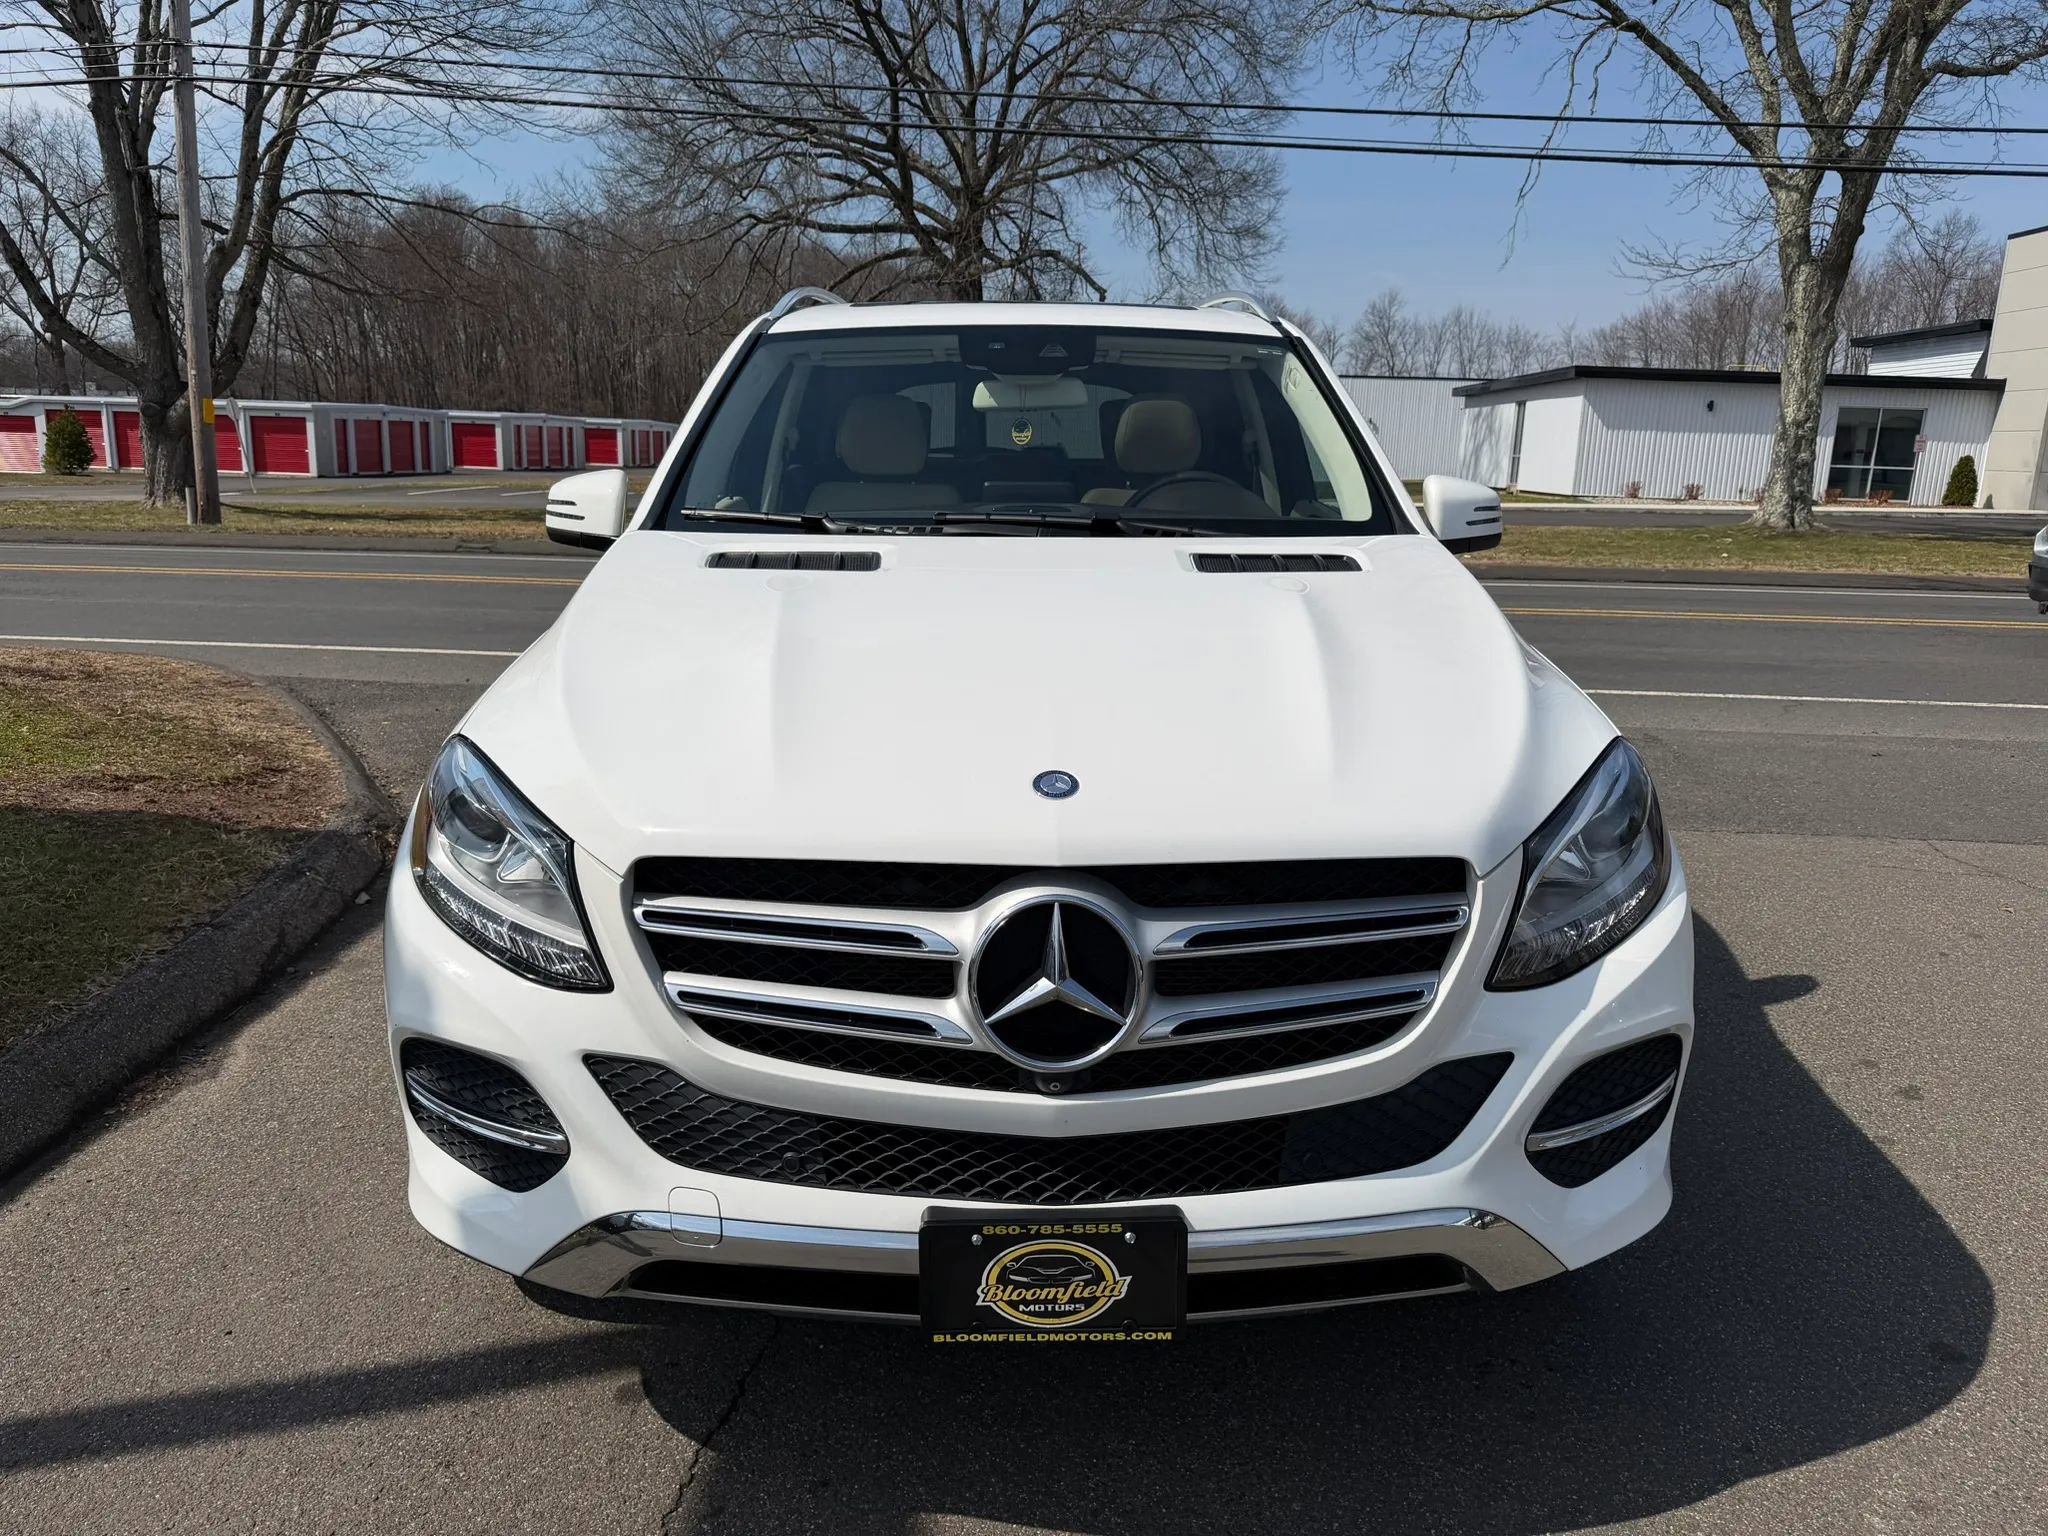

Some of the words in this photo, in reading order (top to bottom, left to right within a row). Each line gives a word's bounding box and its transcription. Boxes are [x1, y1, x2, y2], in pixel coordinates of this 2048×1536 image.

[982, 1224, 1123, 1235] 860-785-5555
[983, 1279, 1125, 1303] Bloomfield
[1019, 1303, 1085, 1312] MOTORS
[933, 1332, 1173, 1343] BLOOMFIELDMOTORS.COM
